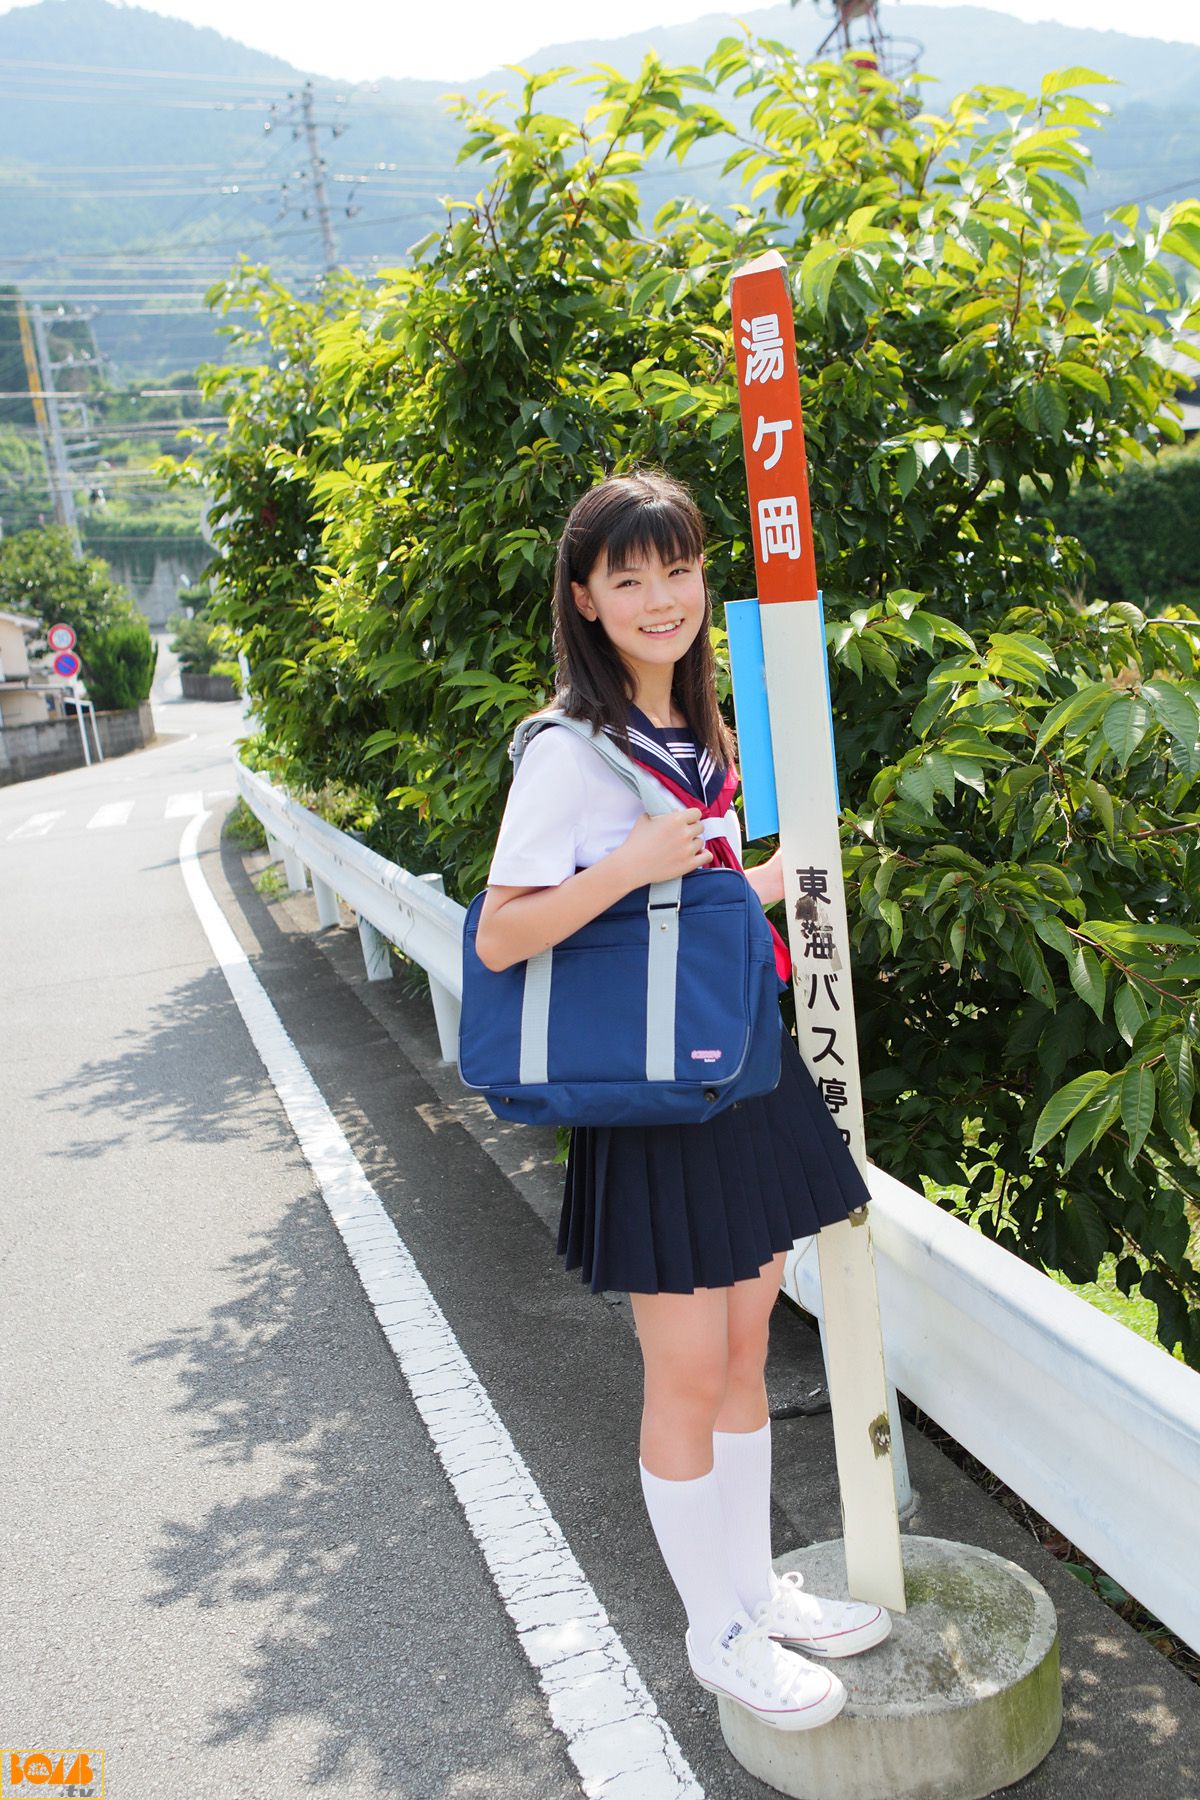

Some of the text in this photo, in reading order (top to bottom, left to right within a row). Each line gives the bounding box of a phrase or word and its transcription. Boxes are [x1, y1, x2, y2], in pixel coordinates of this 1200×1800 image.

[796, 866, 851, 1146] 東海バス停
